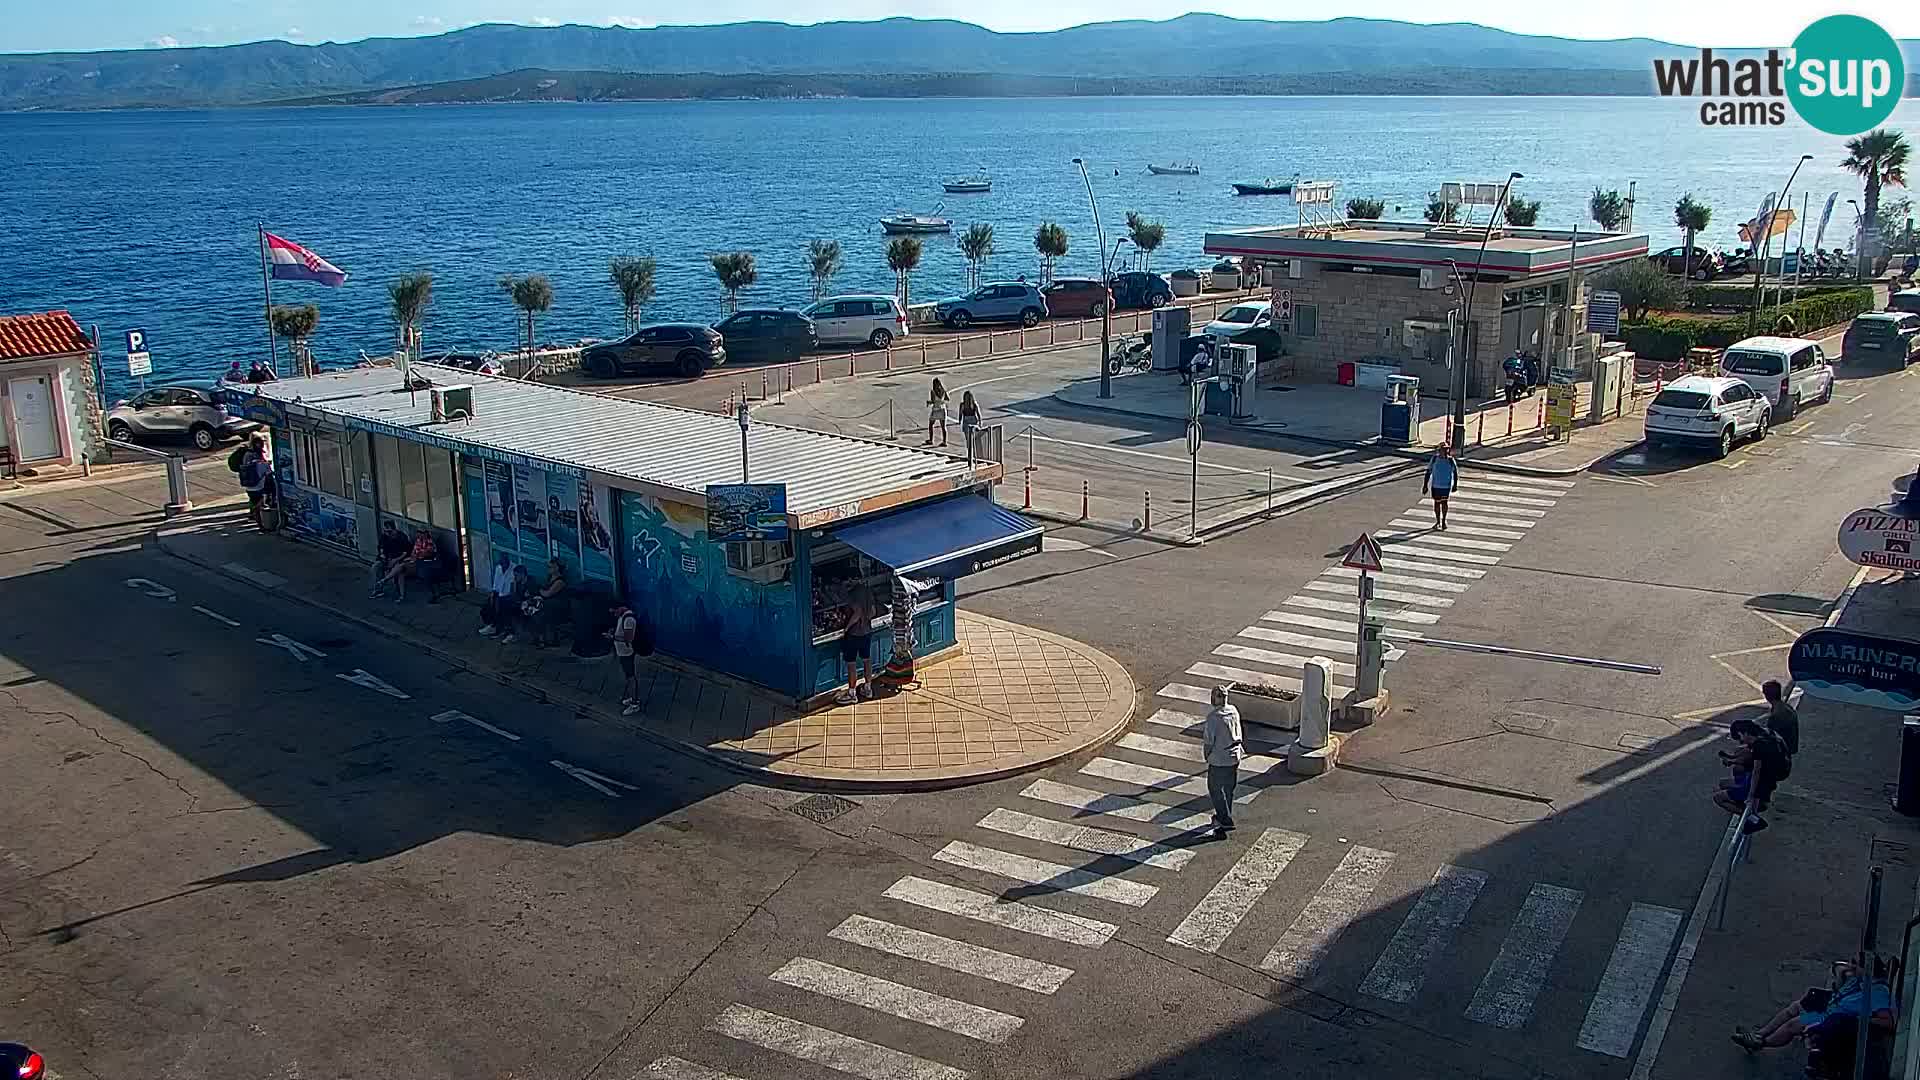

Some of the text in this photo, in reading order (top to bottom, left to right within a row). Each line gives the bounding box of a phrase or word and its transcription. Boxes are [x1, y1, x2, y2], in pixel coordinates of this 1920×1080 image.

[130, 332, 143, 350] P
[478, 446, 582, 478] BUS STATION TICKET OFFICE
[1848, 516, 1920, 532] PIZZE
[1801, 643, 1920, 674] MARINER
[1871, 666, 1897, 681] bar
